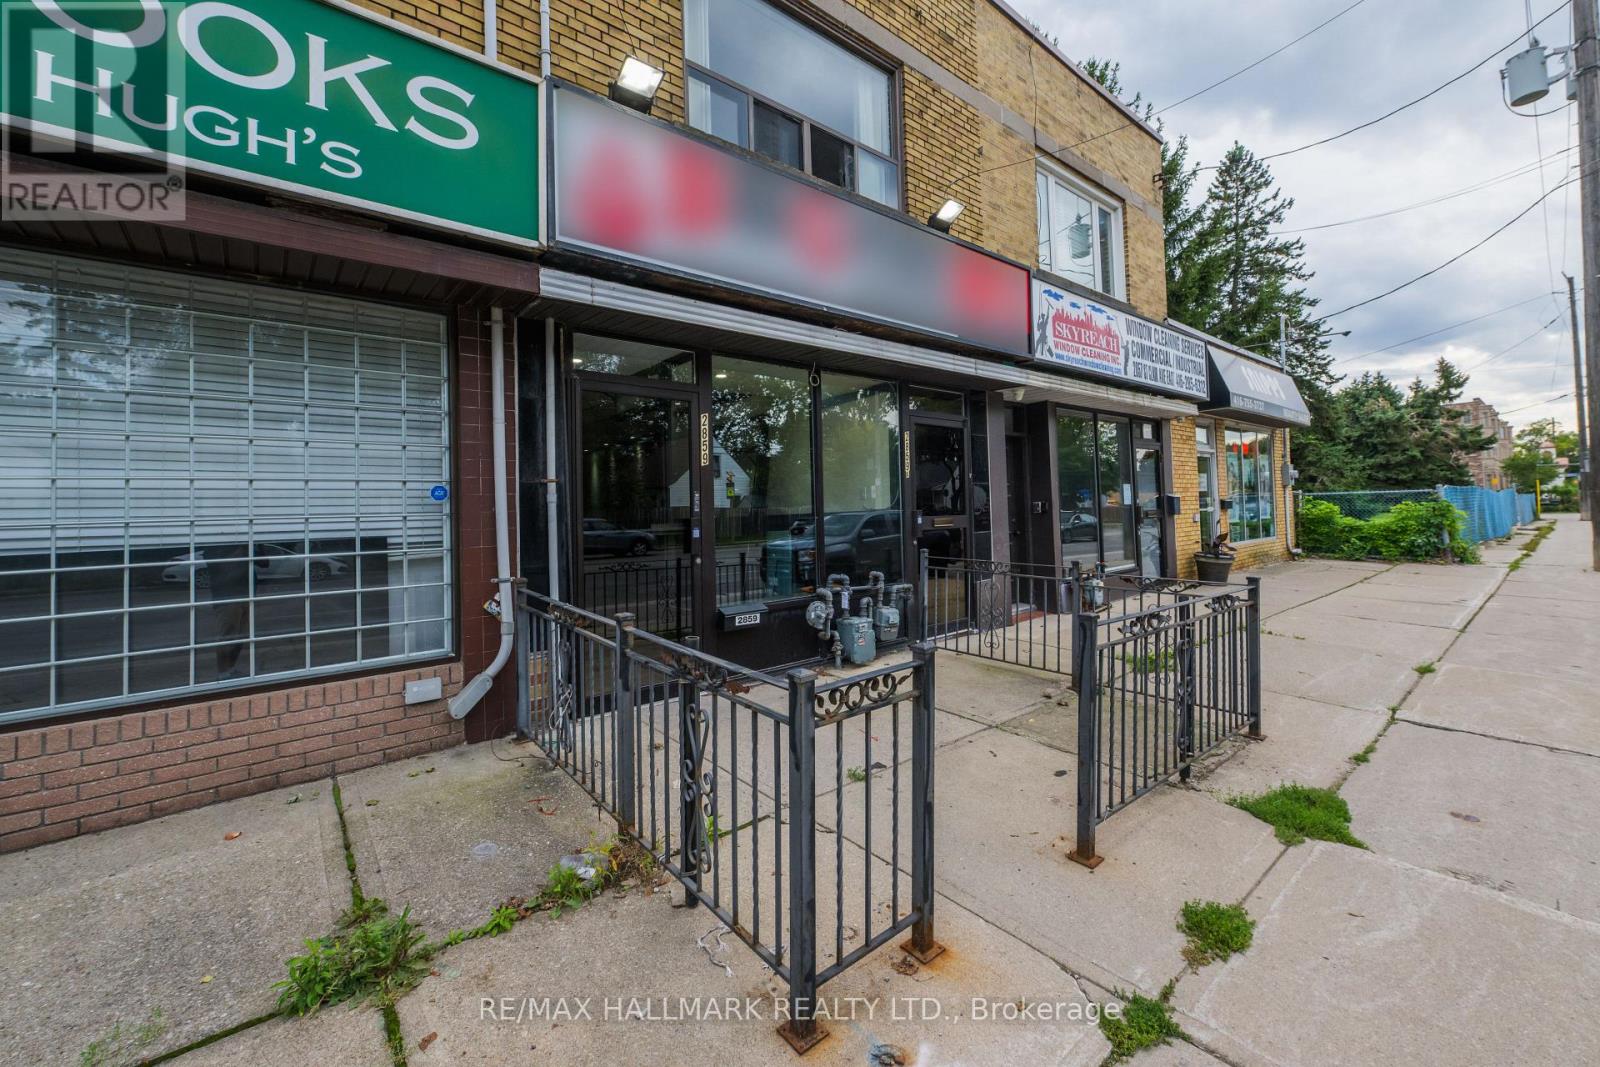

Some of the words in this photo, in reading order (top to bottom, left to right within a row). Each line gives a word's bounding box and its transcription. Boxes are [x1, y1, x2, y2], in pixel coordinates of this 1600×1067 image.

[33, 50, 363, 179] HUGH'S
[1053, 340, 1080, 355] WINDOW
[1081, 346, 1110, 363] CLEANING
[1055, 322, 1119, 352] SKYREACH
[1125, 317, 1153, 343] WINDOW
[1153, 328, 1180, 352] CLEANING
[1181, 337, 1205, 359] SERVICES
[1131, 340, 1172, 367] COMMERCIAL
[1175, 355, 1205, 377] INDUSTRIAL
[737, 614, 758, 624] 2859
